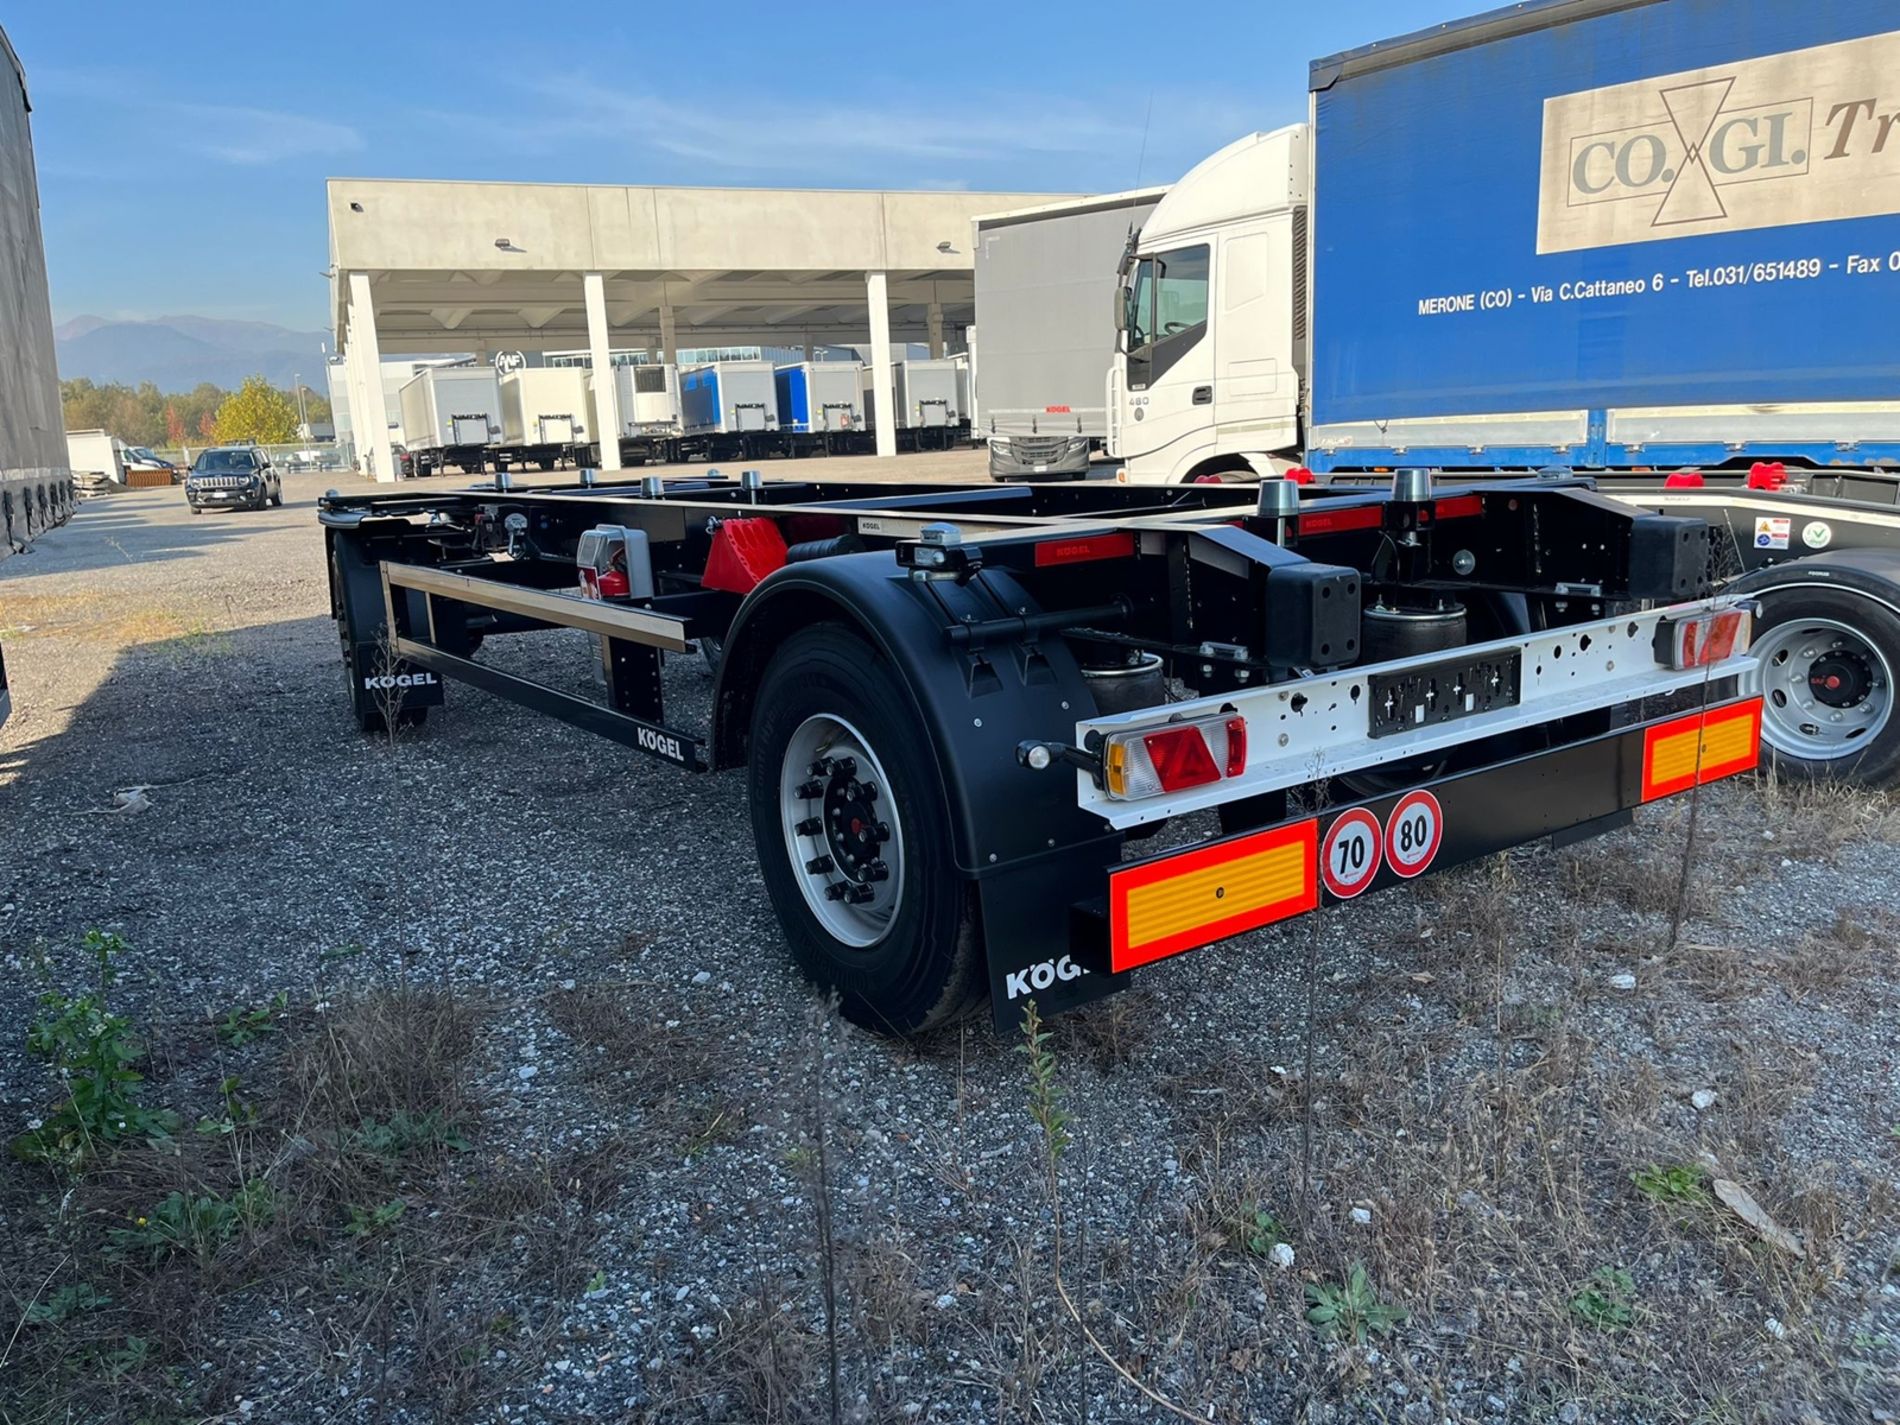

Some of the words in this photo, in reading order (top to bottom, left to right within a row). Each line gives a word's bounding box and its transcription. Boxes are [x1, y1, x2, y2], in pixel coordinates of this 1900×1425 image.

[1418, 294, 1475, 315] MERONE
[1480, 288, 1513, 310] (CO)
[1531, 285, 1553, 303] Via
[1559, 278, 1645, 301] C.Cattaneo
[1651, 272, 1664, 292] 6
[1686, 257, 1821, 288] Tel.031/651489
[1846, 254, 1881, 274] Fax
[364, 672, 437, 690] KÖGEL
[637, 727, 684, 761] KÖGEL
[1400, 815, 1427, 852] 80
[1338, 835, 1365, 875] 70
[1006, 954, 1091, 1000] KÖG
